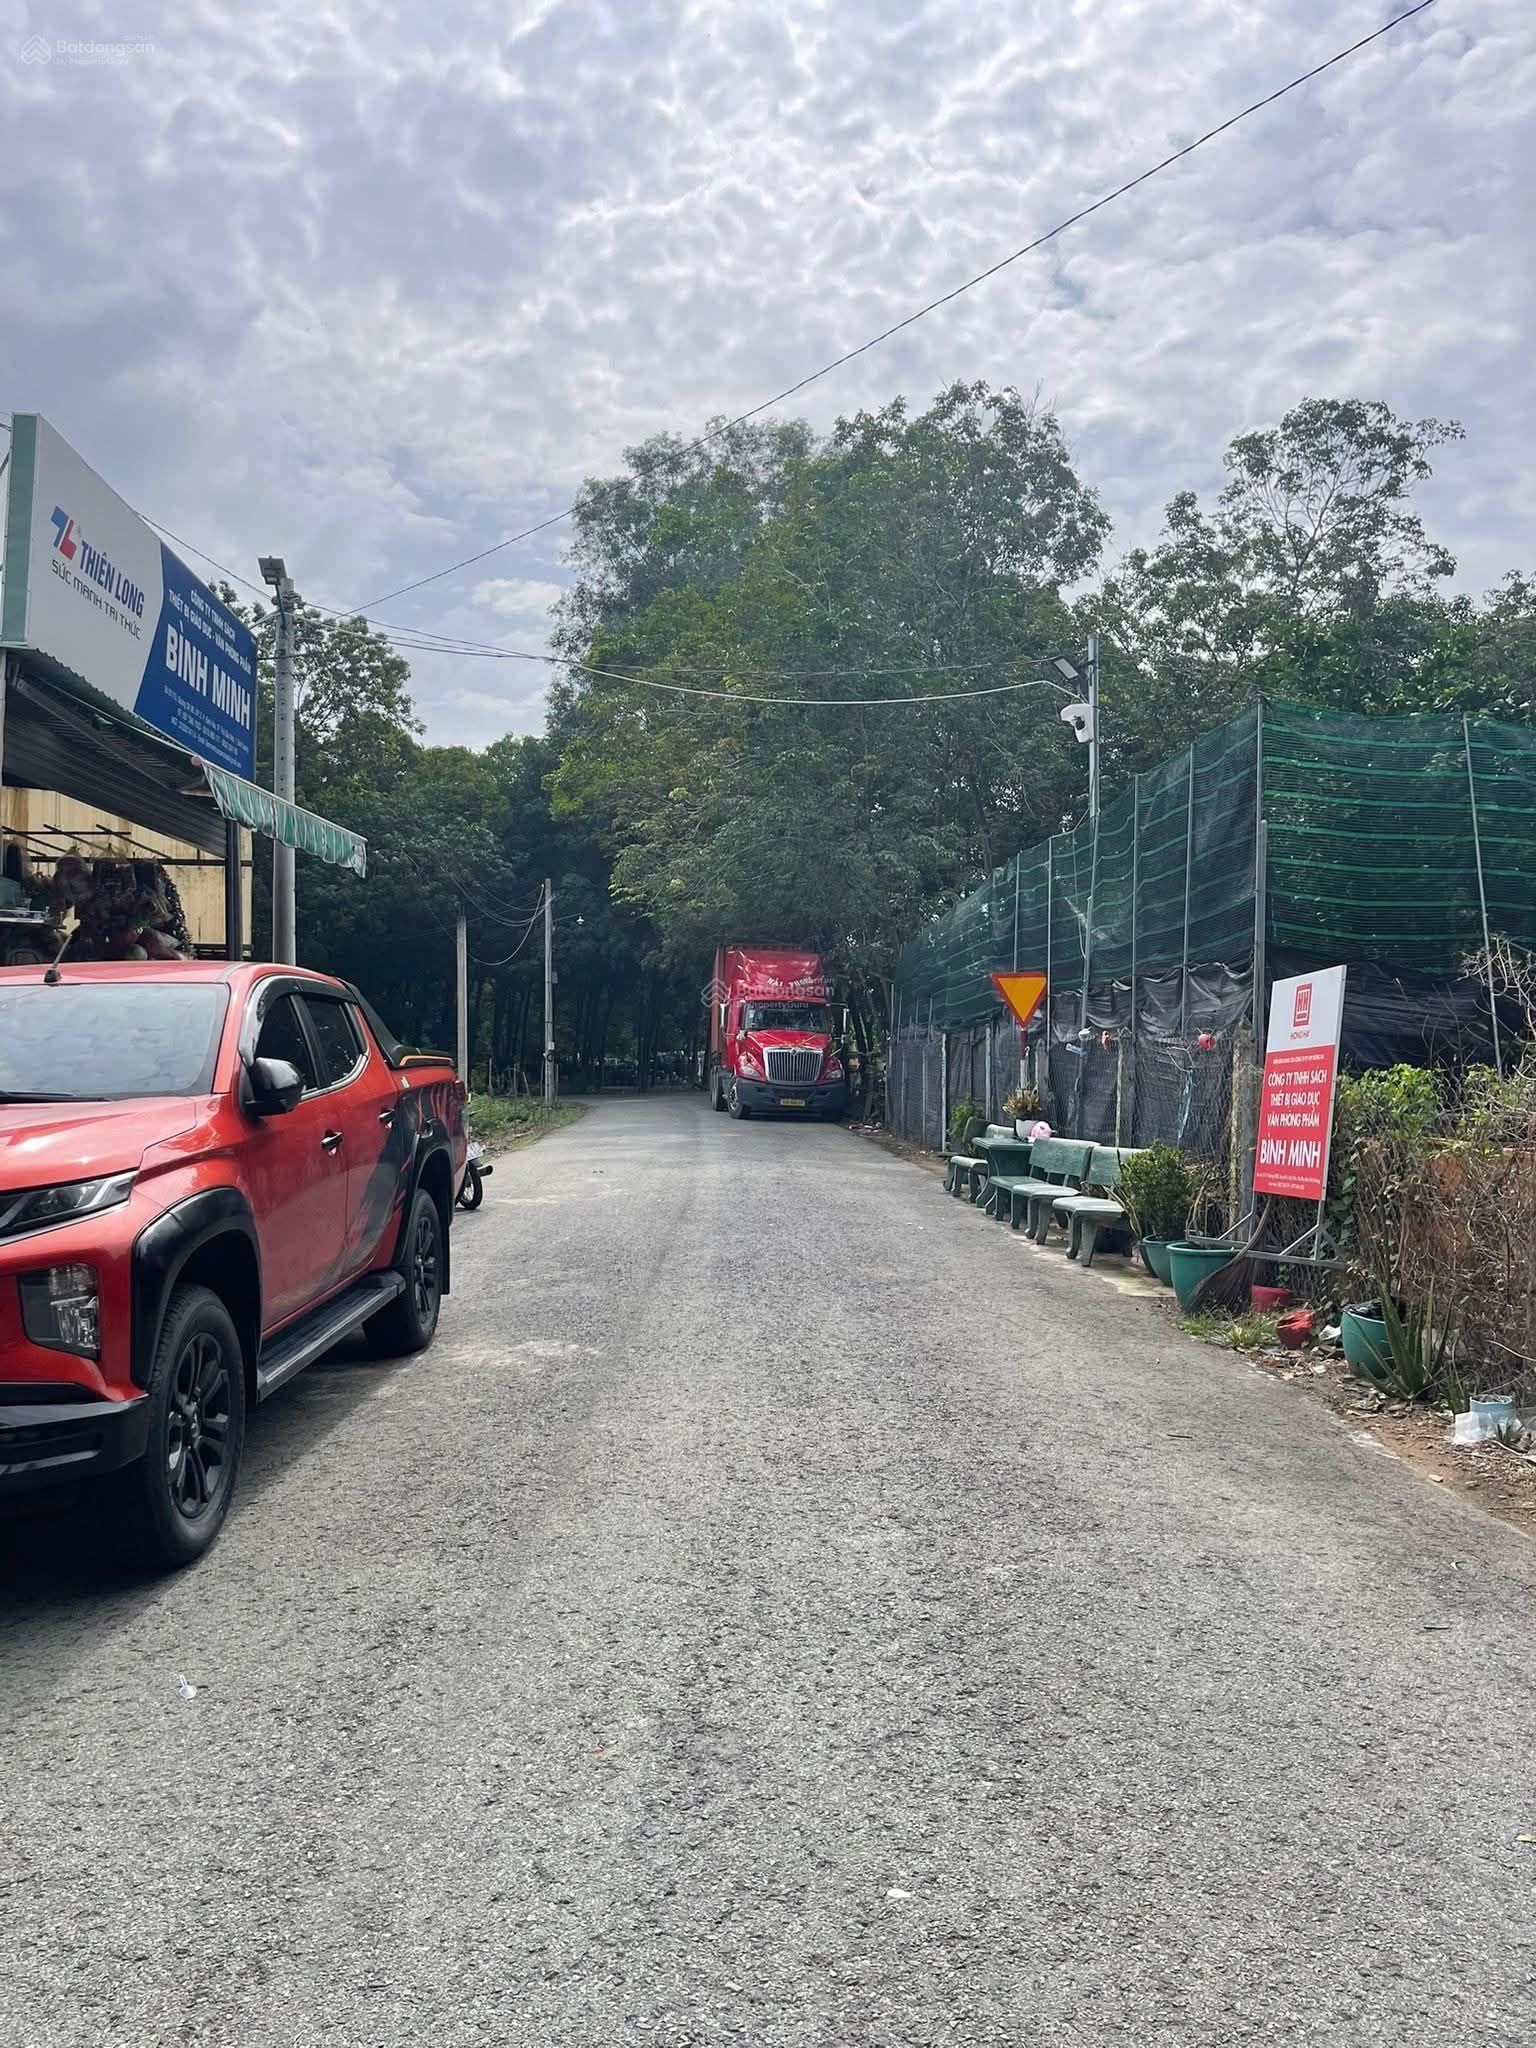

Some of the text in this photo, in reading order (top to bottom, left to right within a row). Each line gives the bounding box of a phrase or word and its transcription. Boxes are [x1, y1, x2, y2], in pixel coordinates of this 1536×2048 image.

[51, 559, 71, 585] SỨC
[104, 600, 118, 622] TRI
[119, 613, 141, 640] THỨC
[80, 540, 145, 619] THIÊN LONG
[166, 620, 208, 696] BÌNH
[212, 664, 251, 731] MINH
[1268, 1065, 1328, 1087] CÔNG TY TNHH SÁCH
[1270, 1090, 1320, 1109] THIẾT BỊ GIÁO DỤC
[1260, 1133, 1321, 1168] BÌNH MINH
